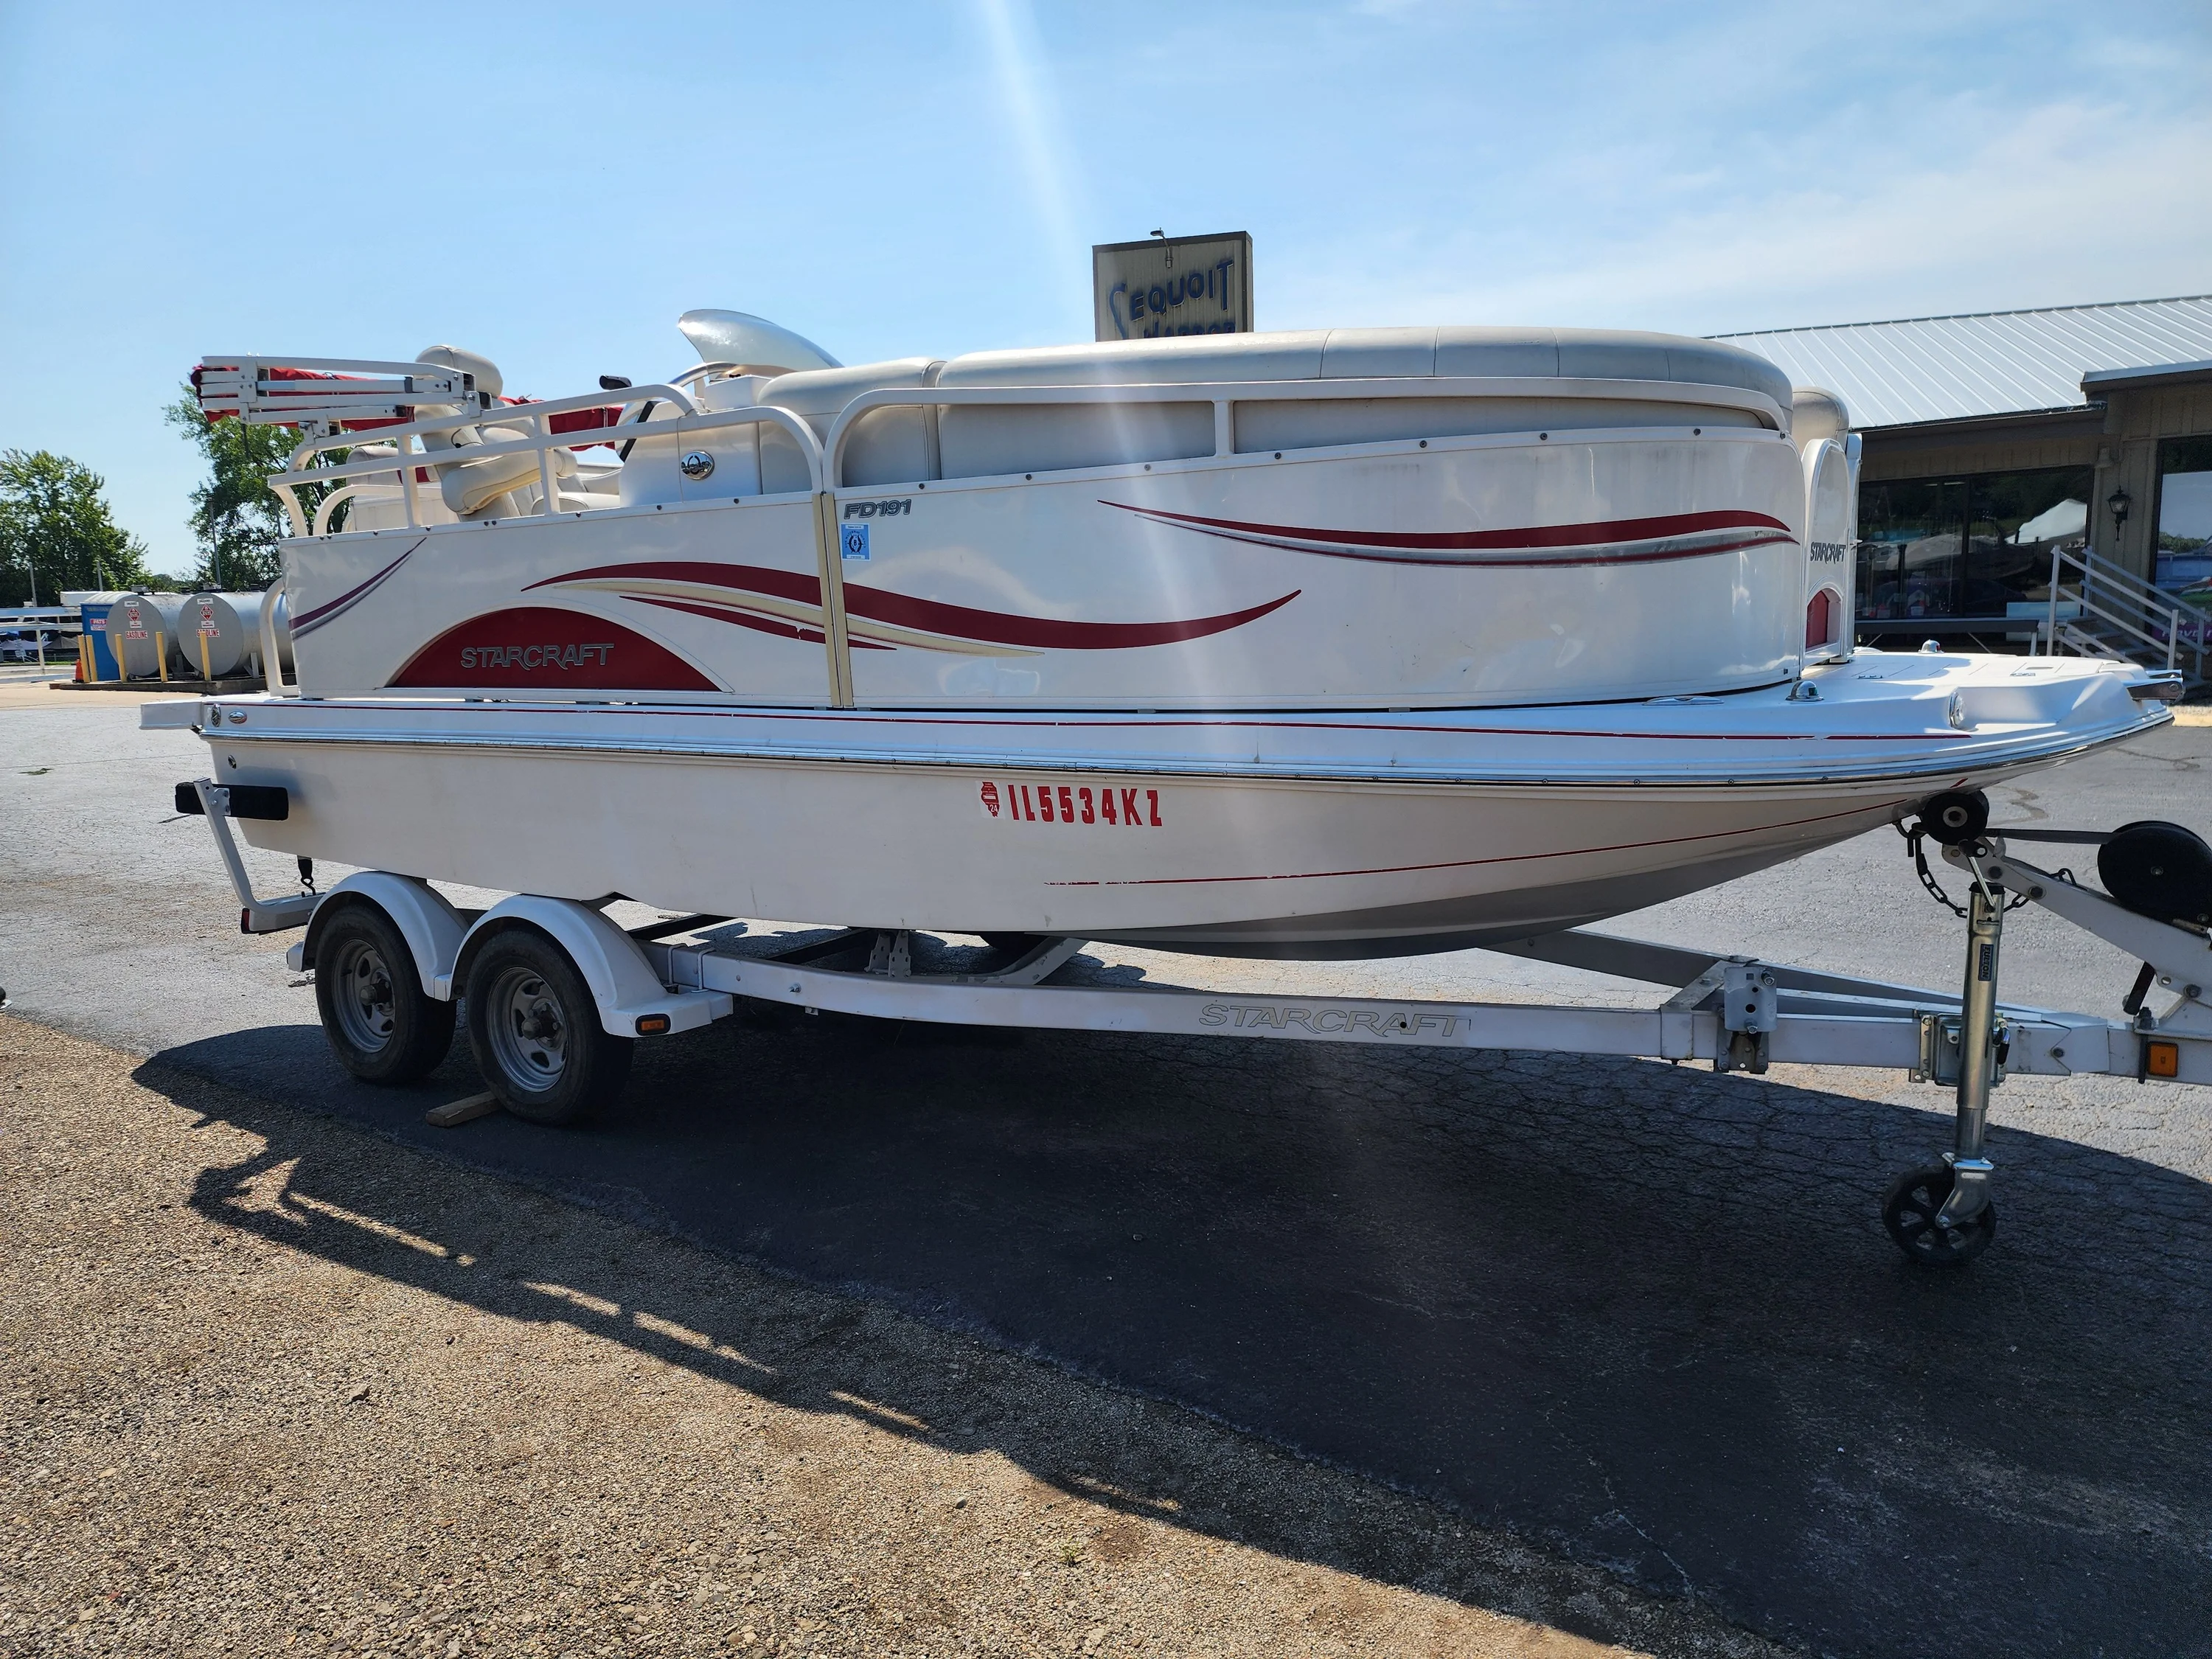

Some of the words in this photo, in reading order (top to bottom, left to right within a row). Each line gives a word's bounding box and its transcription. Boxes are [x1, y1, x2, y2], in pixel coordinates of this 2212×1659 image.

[1109, 259, 1234, 338] SEQUOIT
[844, 499, 911, 519] FD191
[1810, 541, 1846, 564] STARCRAFT
[125, 631, 147, 639] GASOLINE
[461, 644, 614, 670] STARCRAFT
[990, 804, 998, 813] 24
[1982, 946, 1991, 978] FULTON
[1199, 1004, 1471, 1037] STARCRAFT
